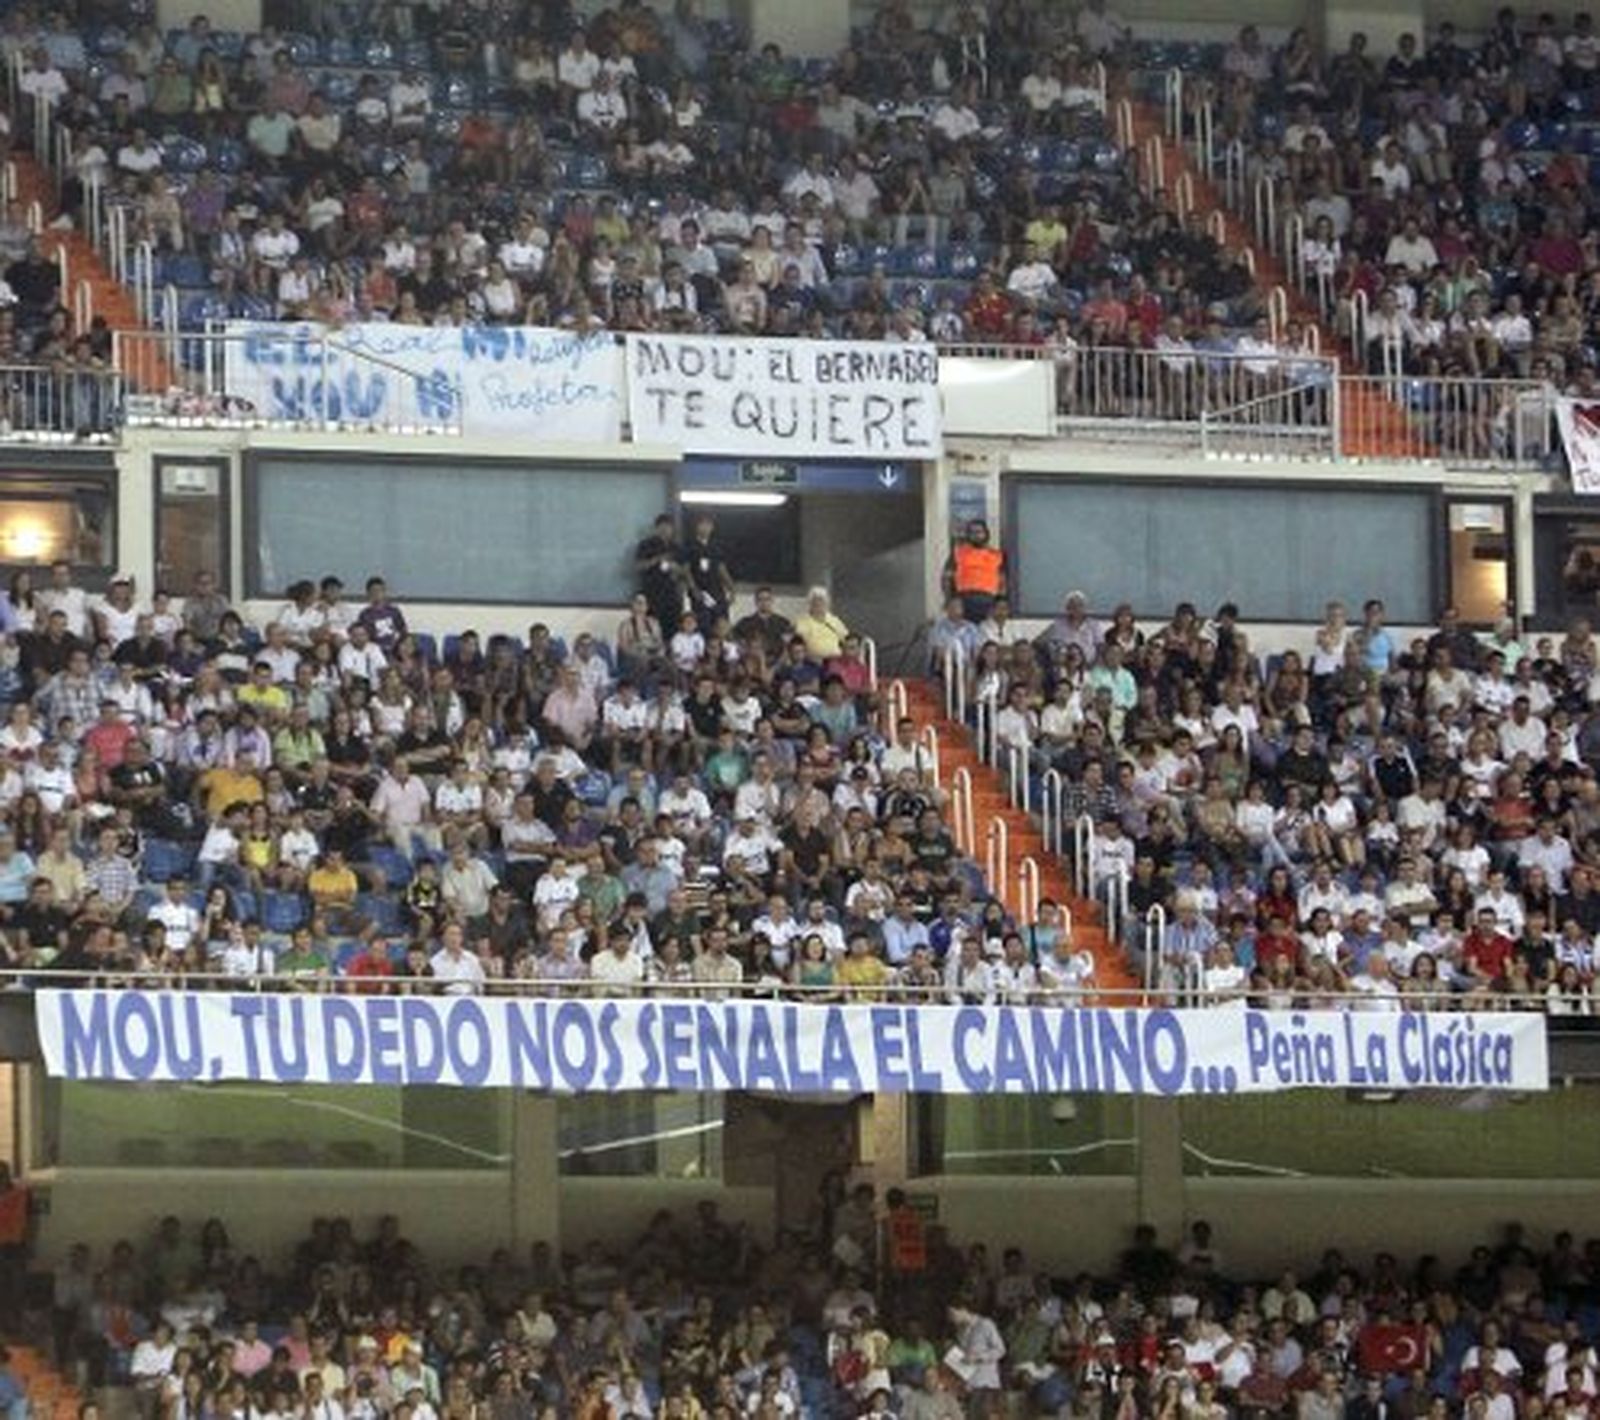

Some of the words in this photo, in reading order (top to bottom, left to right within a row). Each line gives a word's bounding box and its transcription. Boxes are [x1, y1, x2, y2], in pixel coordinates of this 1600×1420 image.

[769, 349, 801, 384] EL
[645, 389, 706, 429] TE
[731, 390, 931, 450] QUIERE
[231, 995, 309, 1081] TU
[322, 998, 493, 1087] DEDO
[505, 1001, 623, 1090] NOS
[871, 1008, 942, 1092] EL
[1245, 1011, 1337, 1084] Peña
[1343, 1010, 1389, 1084] La
[1397, 1011, 1514, 1084] Clásica
